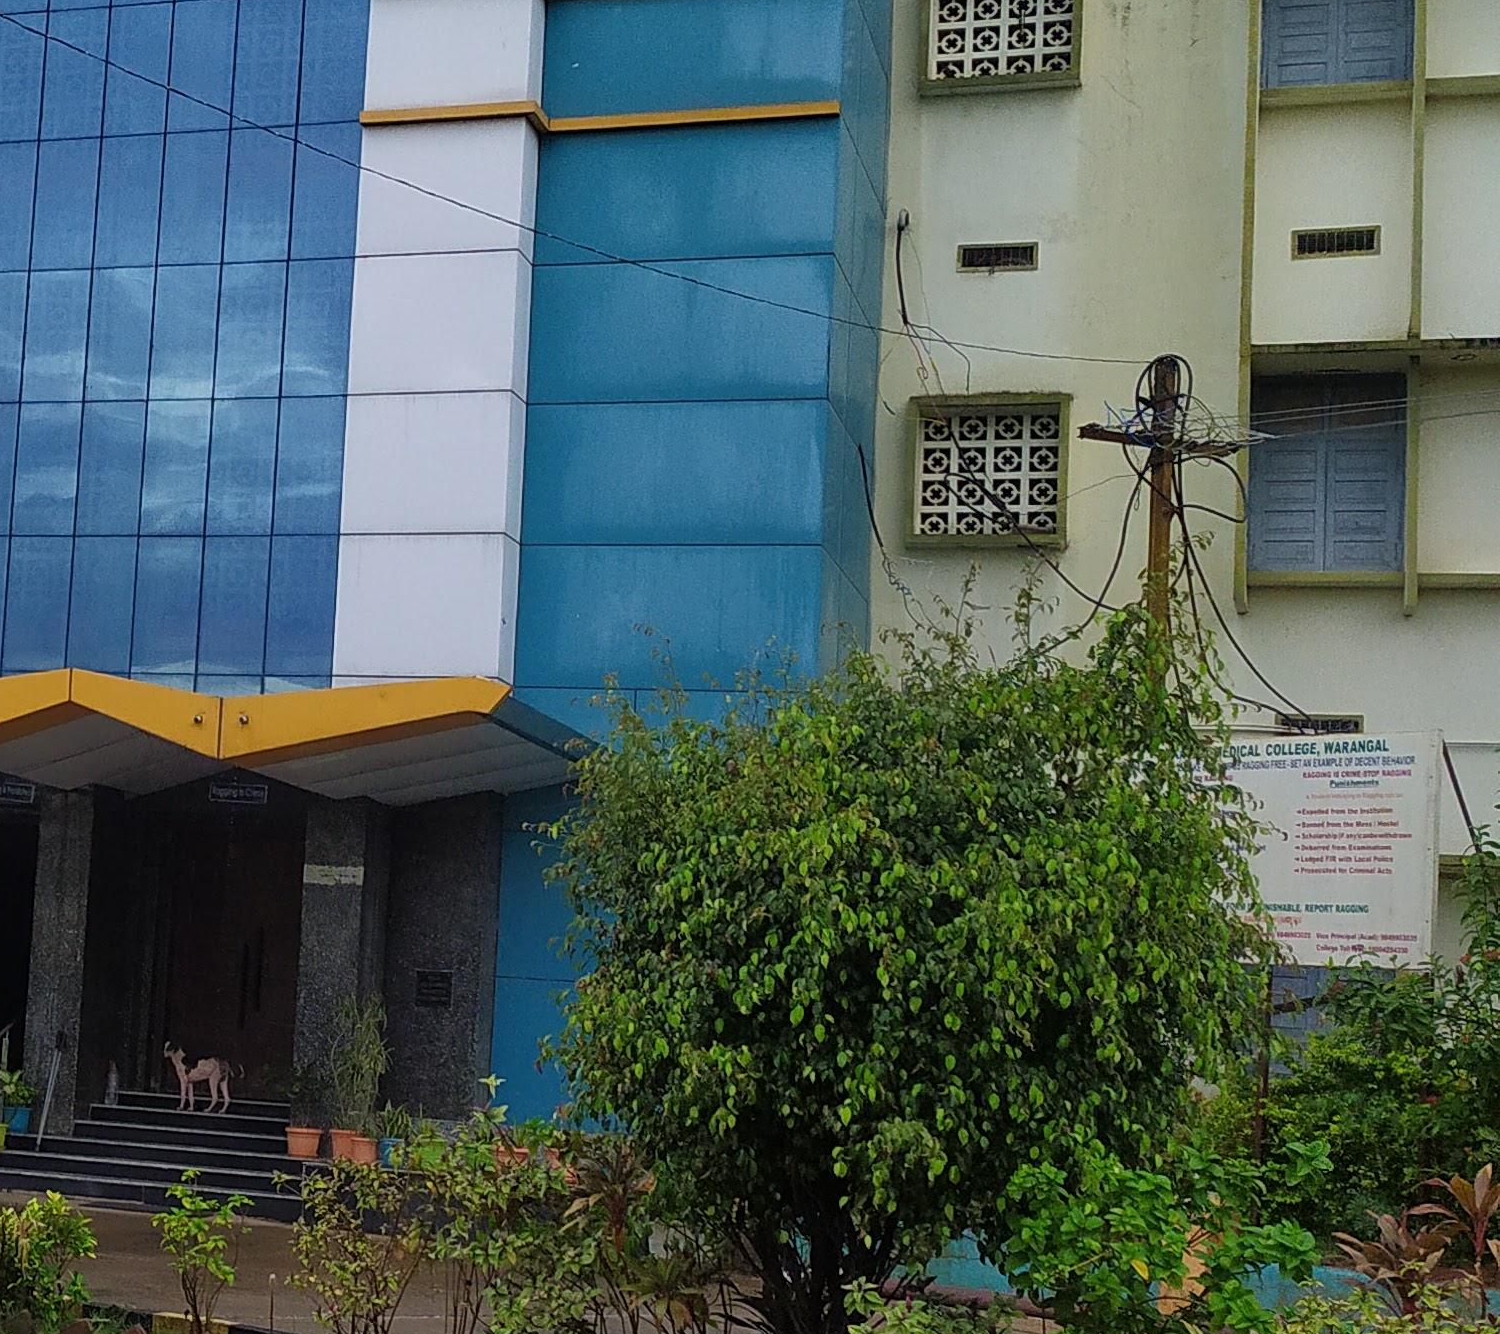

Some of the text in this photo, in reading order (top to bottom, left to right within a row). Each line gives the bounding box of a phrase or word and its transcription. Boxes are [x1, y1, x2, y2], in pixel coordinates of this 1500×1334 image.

[1266, 742, 1320, 756] COLLEGE,
[1324, 739, 1389, 754] WARANGAL
[1313, 758, 1343, 767] EXAMPLE
[1354, 757, 1380, 766] DECENT
[1381, 756, 1415, 766] BEHAVIOR
[1329, 779, 1379, 788] Punishments
[1304, 903, 1333, 912] REPORT
[1335, 904, 1369, 913] RAGGING
[1330, 932, 1356, 940] Principal
[1316, 944, 1338, 952] College
